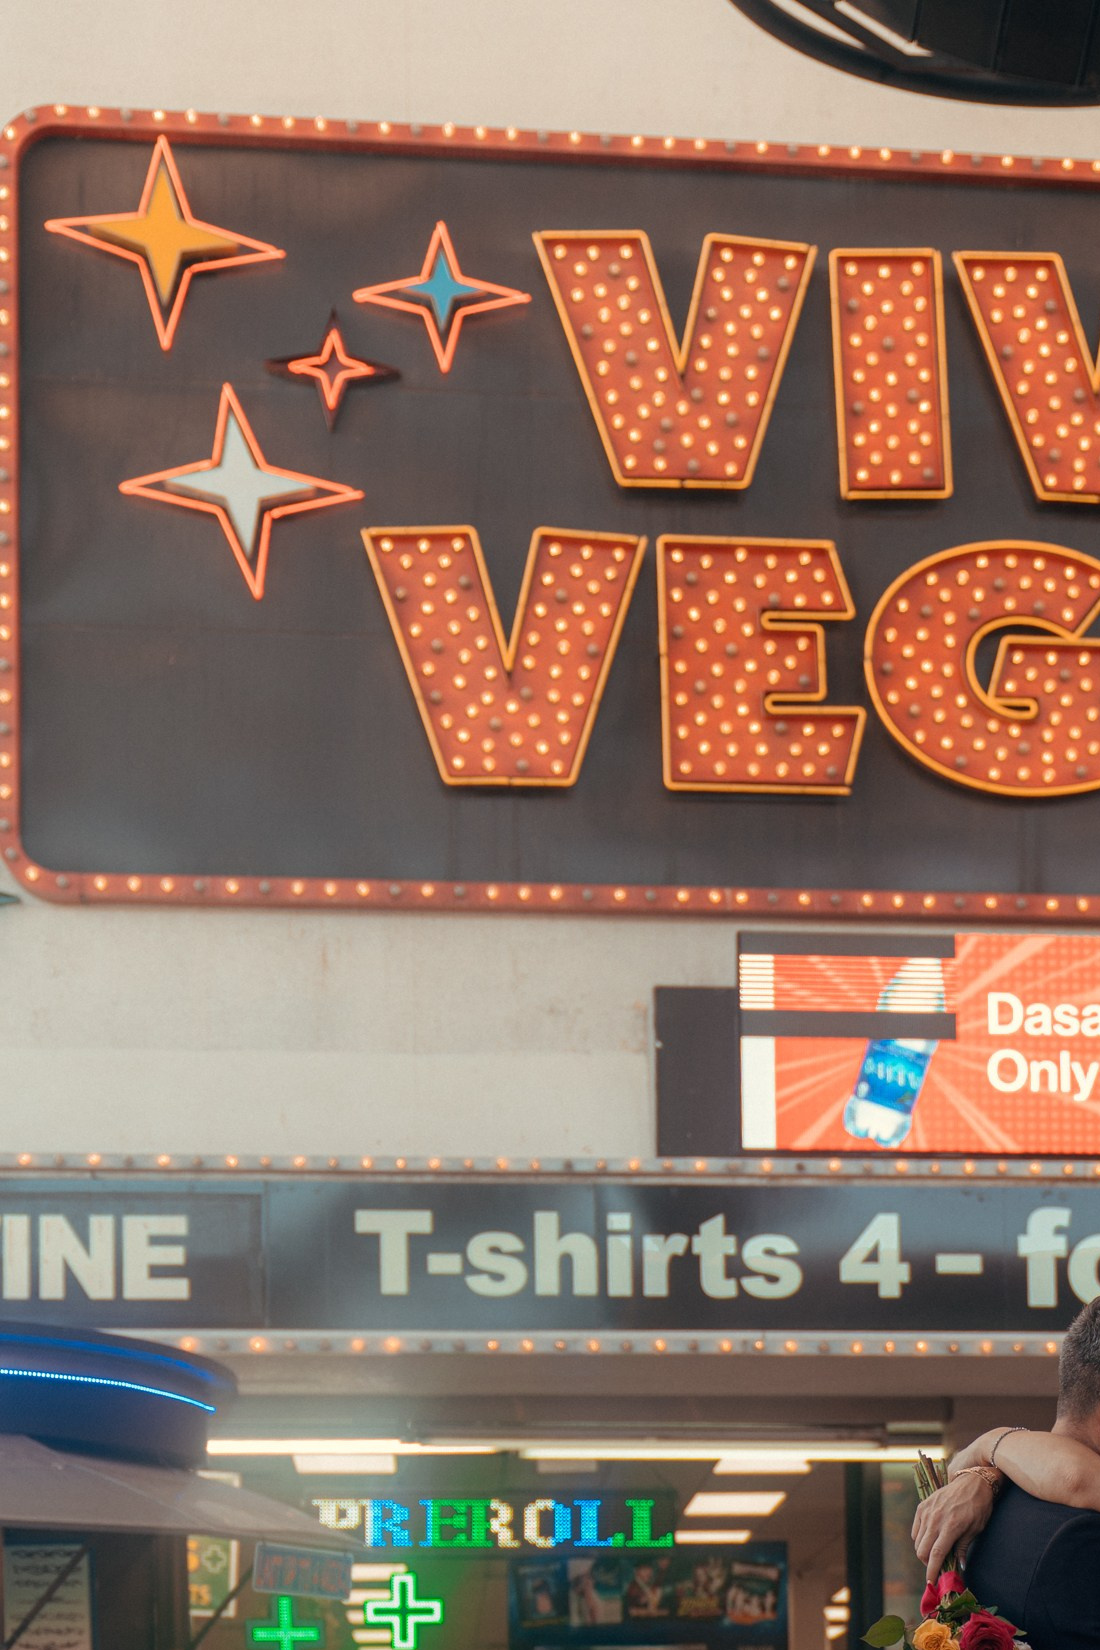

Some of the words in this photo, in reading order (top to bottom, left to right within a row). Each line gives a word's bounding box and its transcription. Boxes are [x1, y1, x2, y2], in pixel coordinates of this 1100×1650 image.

[987, 1049, 1098, 1102] Only
[354, 1209, 803, 1298] T-shirts
[839, 1212, 910, 1298] 4
[311, 1498, 674, 1548] PREROLL
